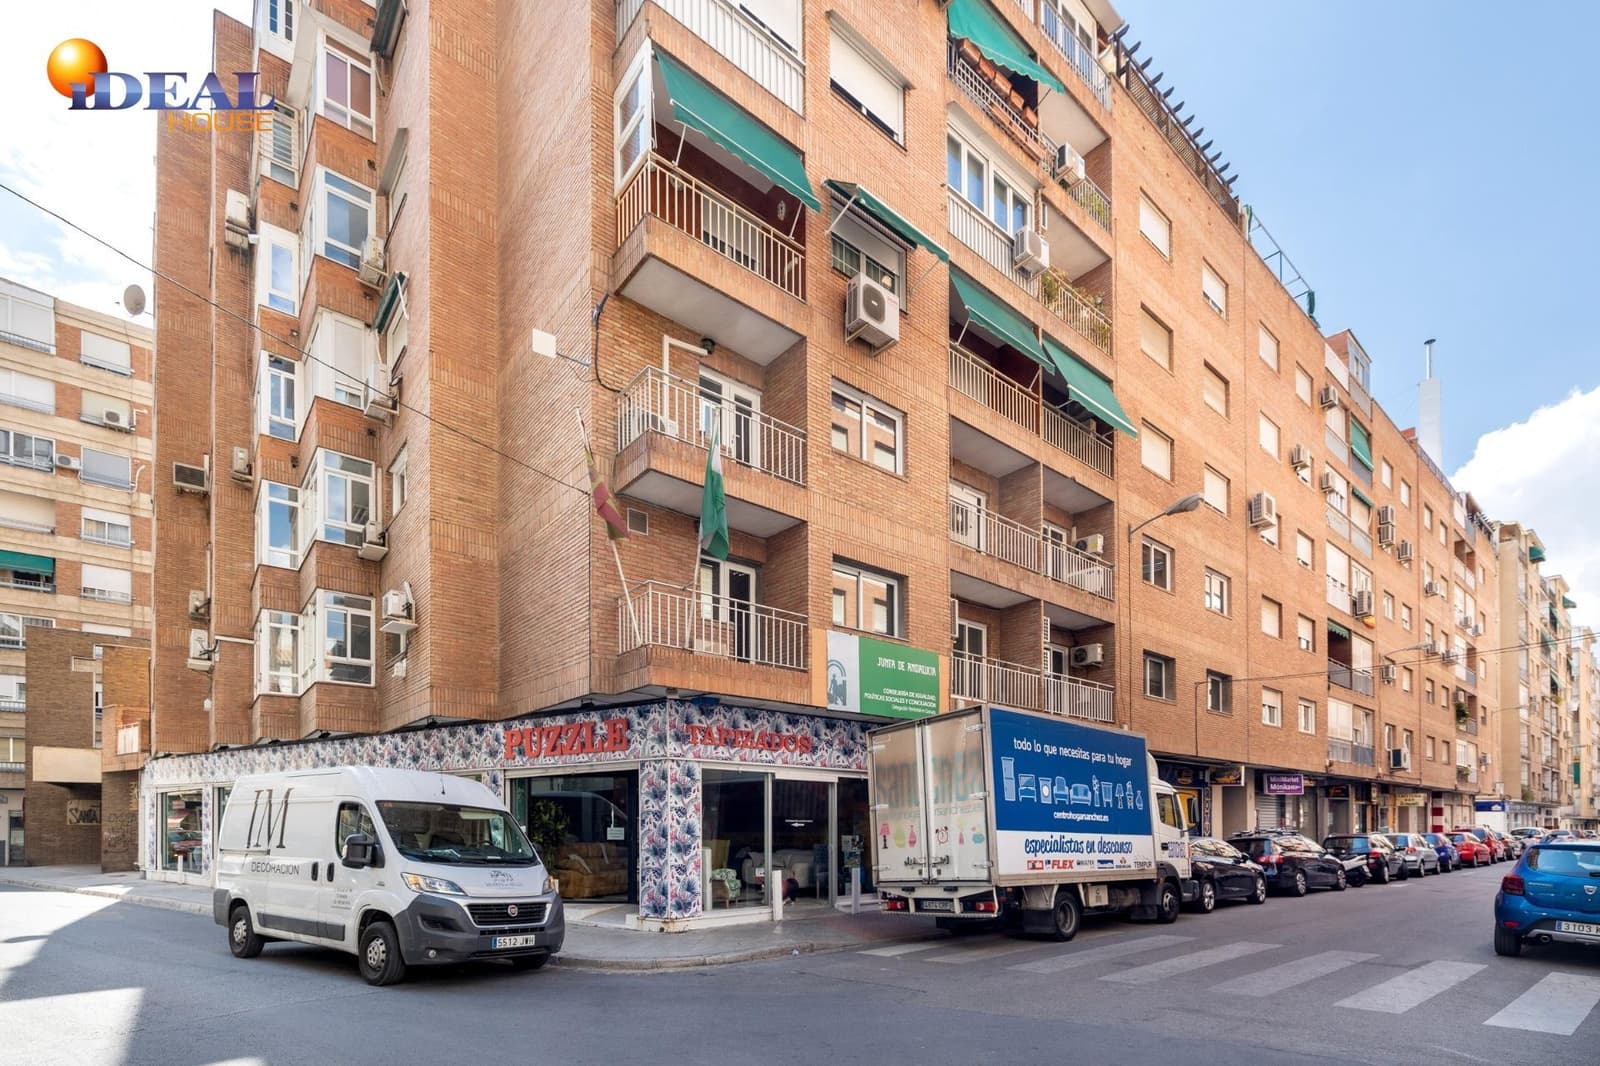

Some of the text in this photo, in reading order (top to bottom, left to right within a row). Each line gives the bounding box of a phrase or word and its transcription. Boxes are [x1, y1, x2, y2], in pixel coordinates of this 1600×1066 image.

[877, 656, 896, 669] JUNTA
[897, 660, 905, 671] DE
[504, 718, 630, 760] PUZZLE
[686, 725, 813, 753] TAPIZADOS
[1013, 737, 1133, 769] todo lo que necesitas para tu hogar
[1024, 834, 1133, 857] especialistas en descanso
[1051, 859, 1074, 870] FLEX
[1563, 922, 1592, 933] 3103
[497, 938, 518, 947] 5512
